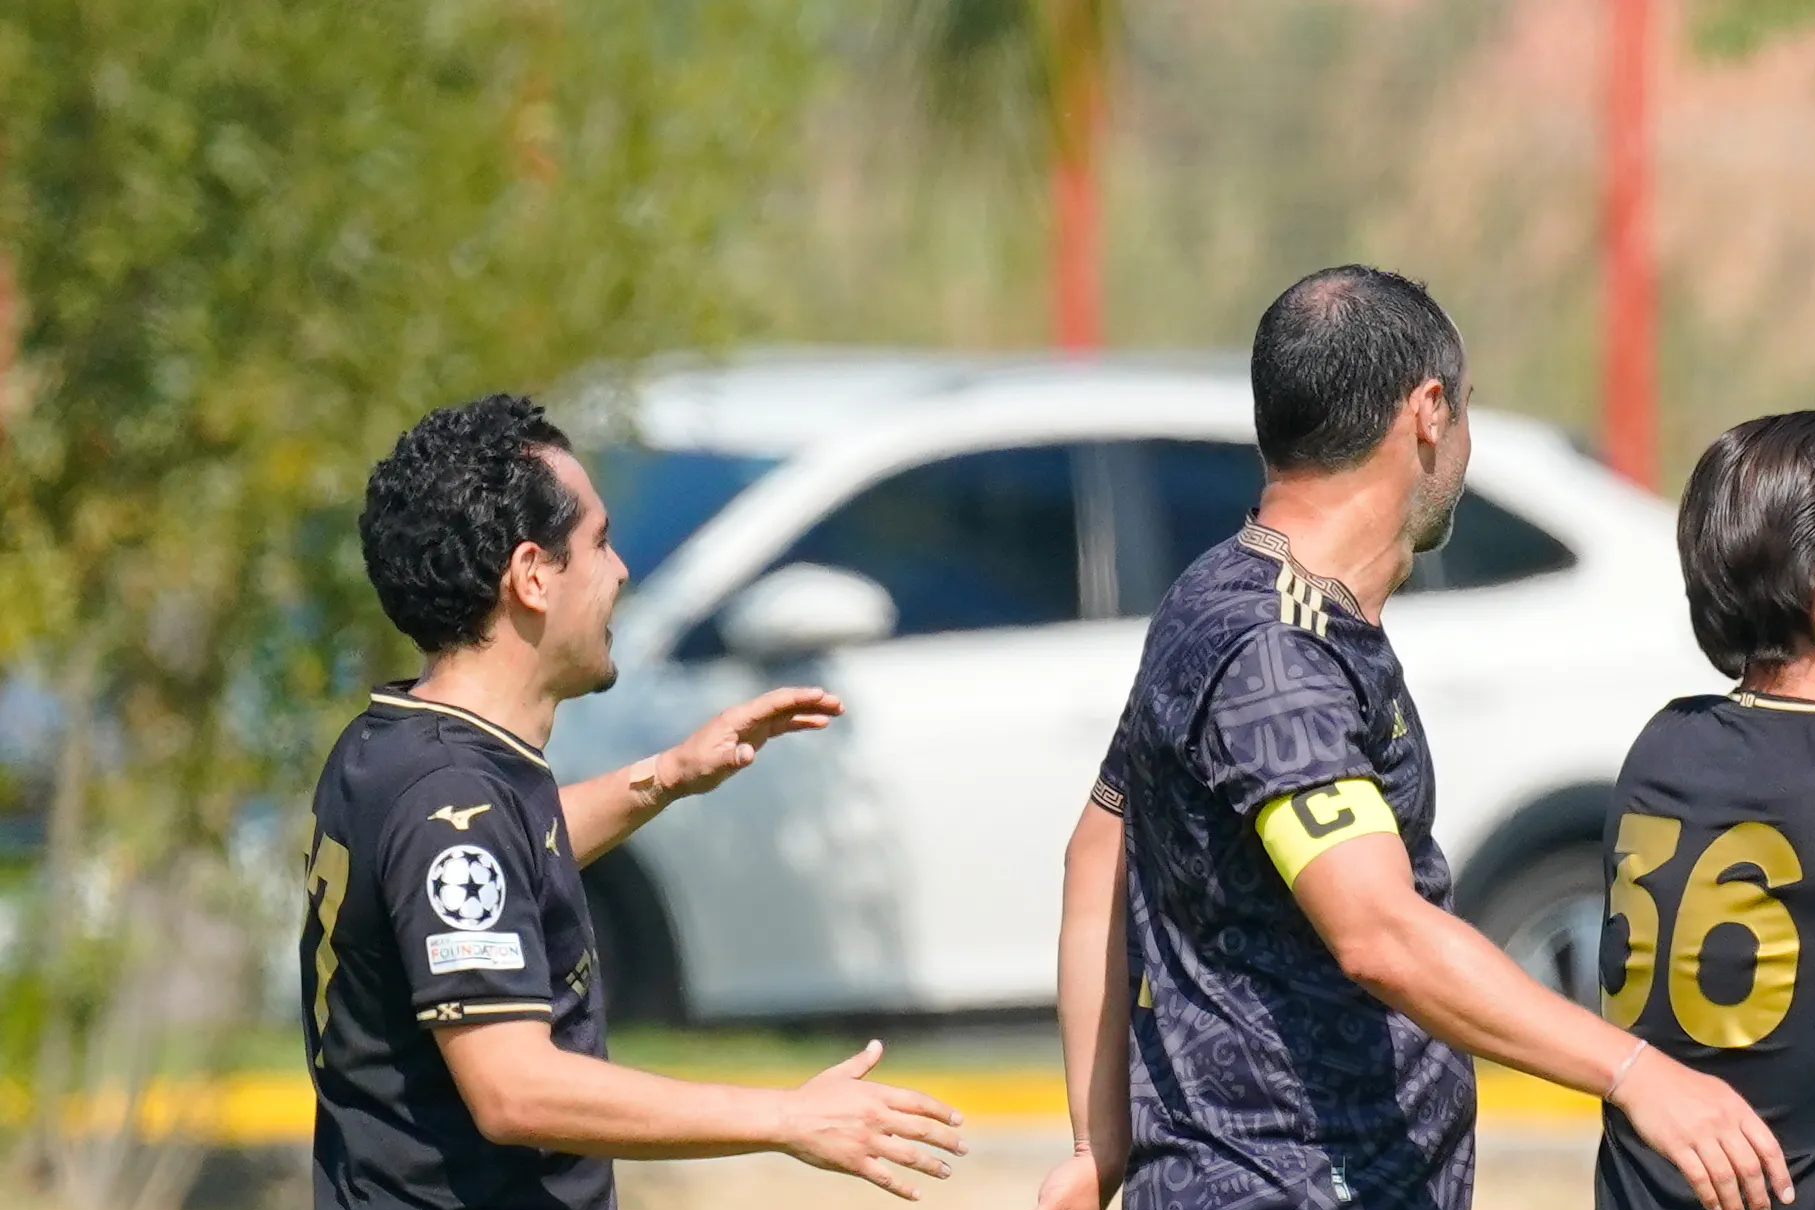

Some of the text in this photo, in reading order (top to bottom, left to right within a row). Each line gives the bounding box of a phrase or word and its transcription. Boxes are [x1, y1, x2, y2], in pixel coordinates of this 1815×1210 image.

[1291, 784, 1356, 839] C
[304, 812, 349, 1069] 7
[431, 944, 519, 961] FOUNDATION
[1601, 813, 1803, 1048] 36
